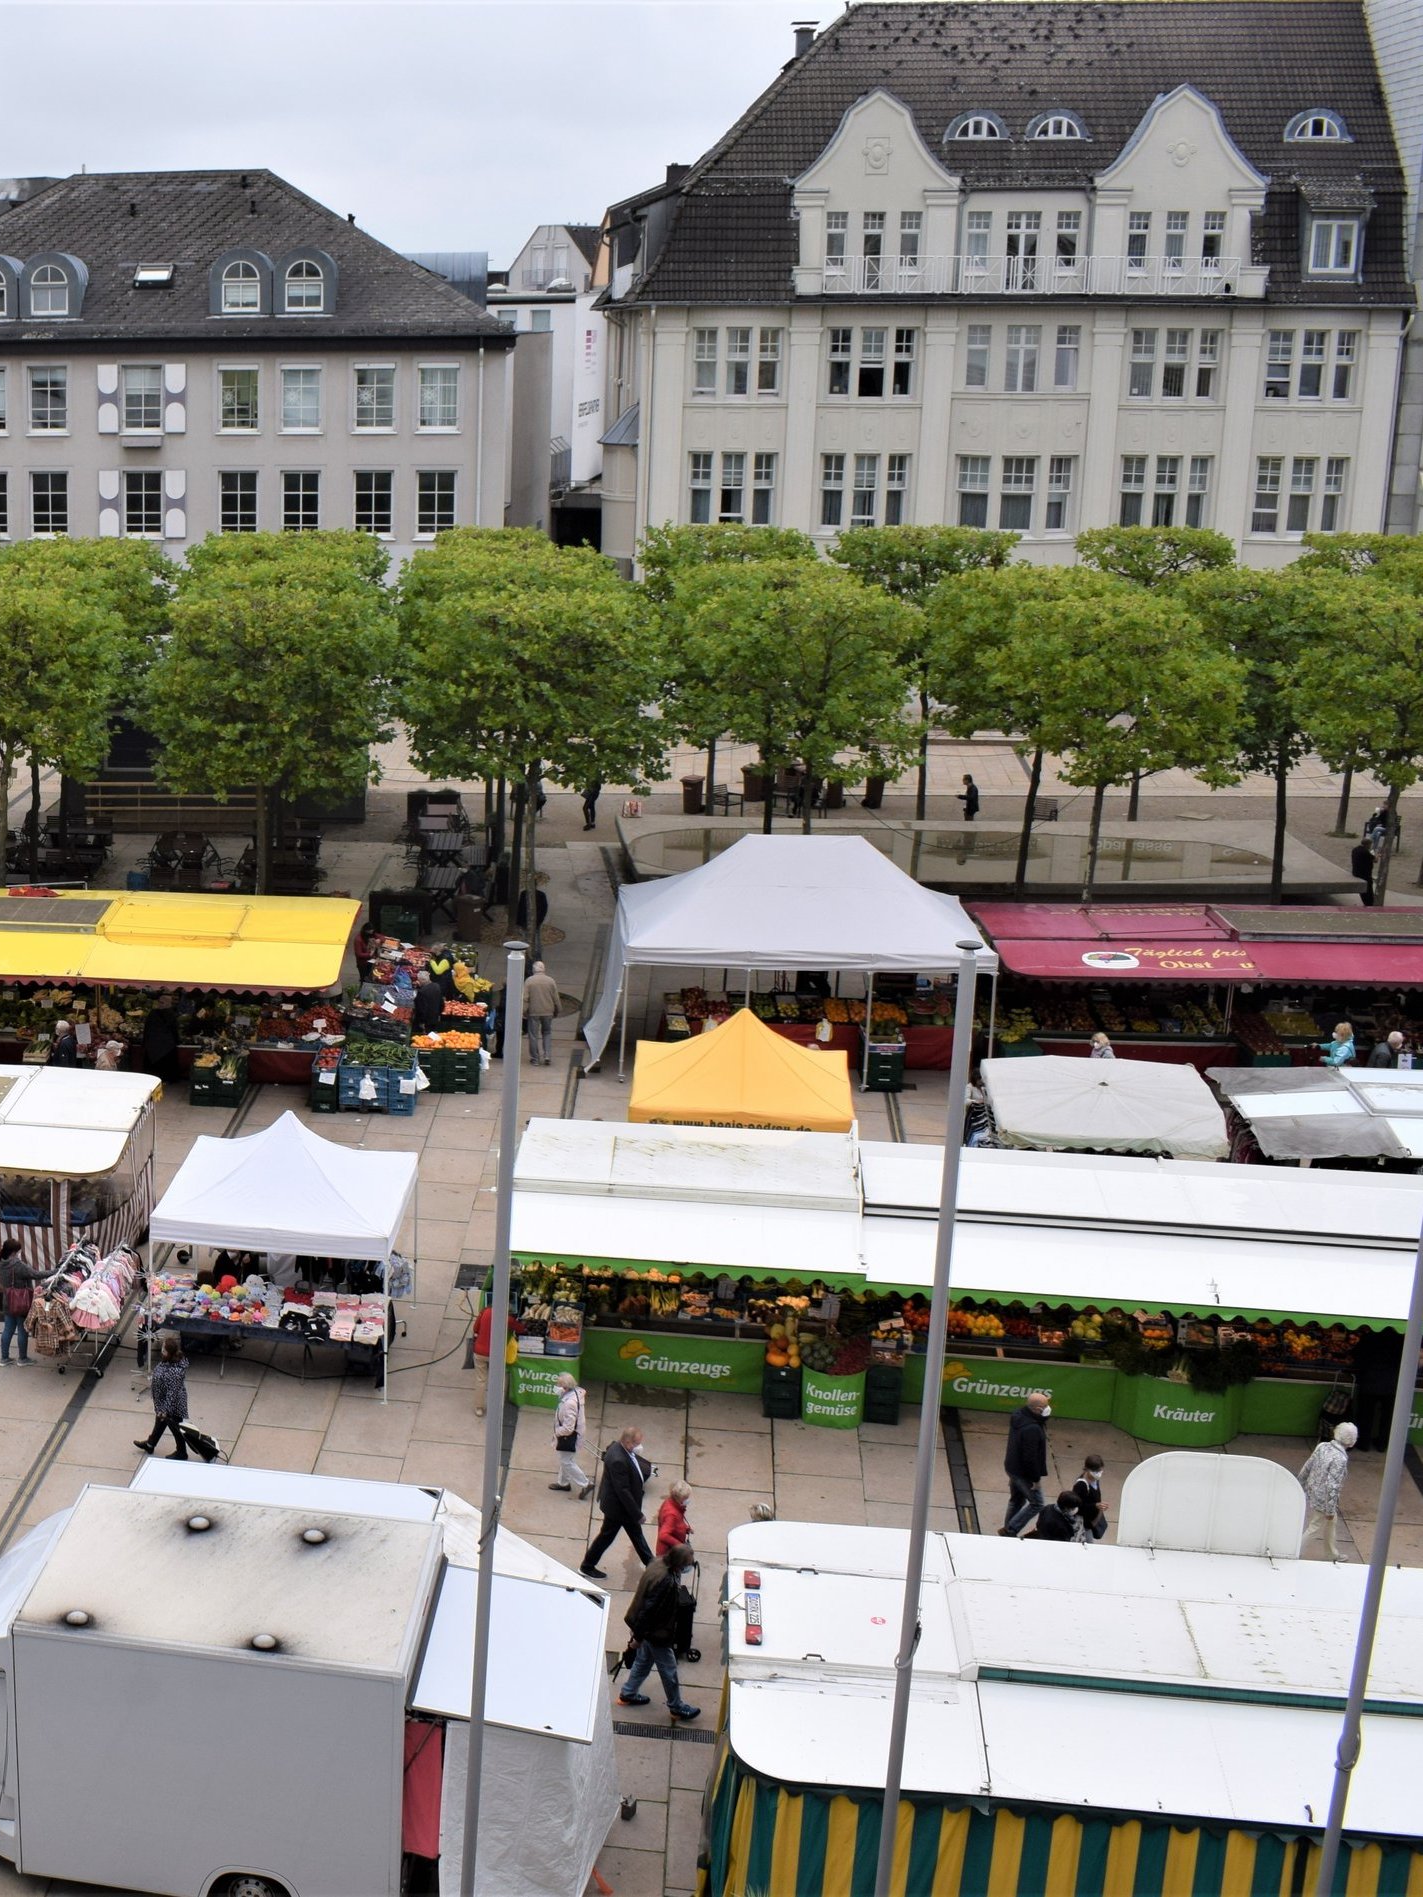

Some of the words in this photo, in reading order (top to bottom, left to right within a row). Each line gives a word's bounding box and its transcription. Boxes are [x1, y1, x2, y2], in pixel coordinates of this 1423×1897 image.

[1125, 947, 1205, 959] Täglich
[1213, 948, 1247, 958] fris
[1159, 960, 1212, 970] Obst
[635, 1353, 731, 1378] Grünzeugs
[518, 1368, 558, 1382] Wurze
[518, 1382, 556, 1395] gemü
[806, 1382, 860, 1402] Knollen-
[806, 1400, 858, 1417] gemüse
[1153, 1404, 1216, 1423] Kräuter
